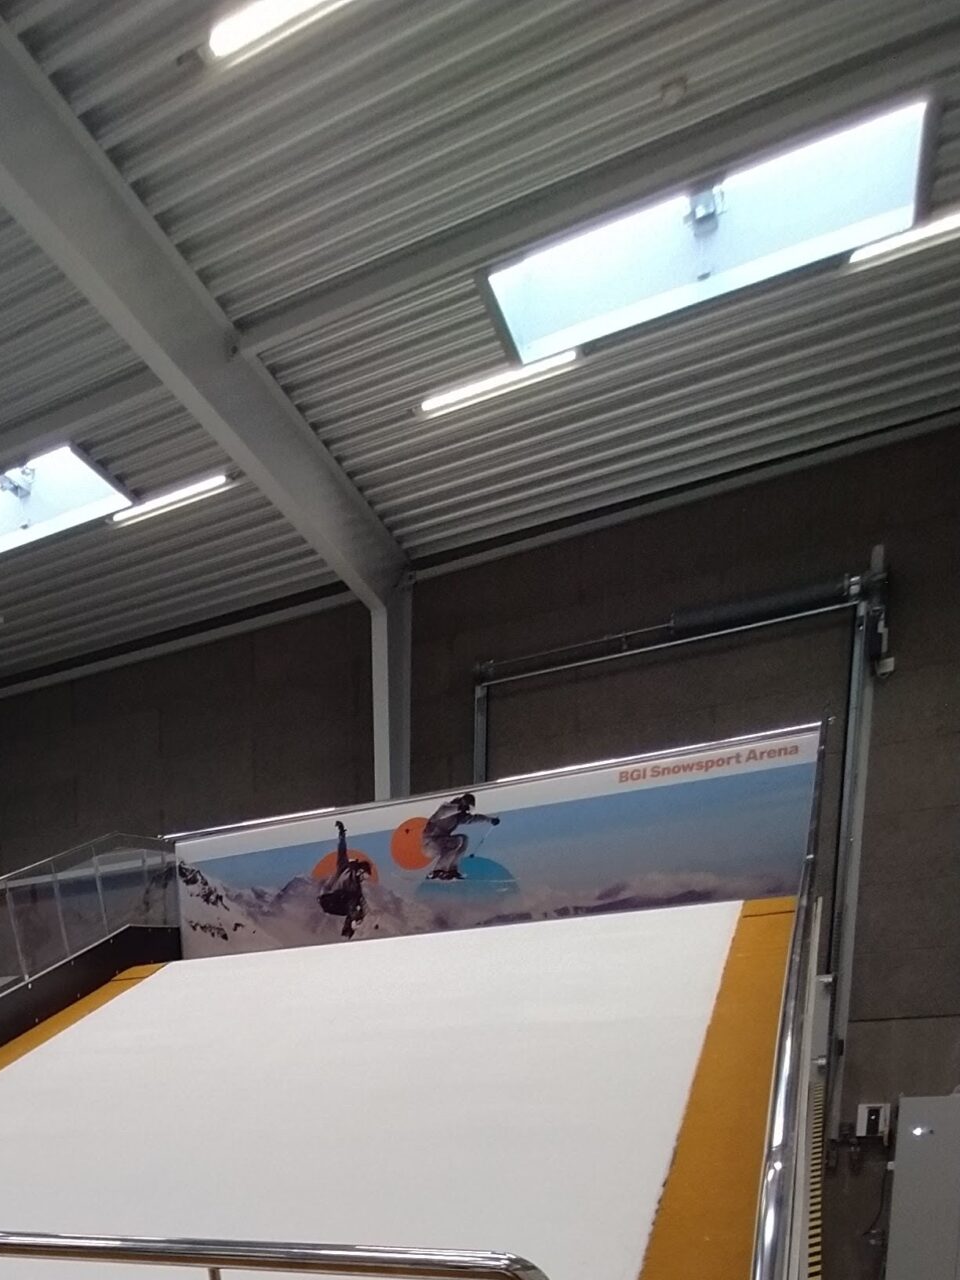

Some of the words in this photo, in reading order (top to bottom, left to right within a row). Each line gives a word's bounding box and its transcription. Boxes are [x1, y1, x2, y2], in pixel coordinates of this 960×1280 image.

[618, 770, 646, 784] BGI
[650, 752, 742, 778] Snowsport
[745, 744, 799, 762] Arena
